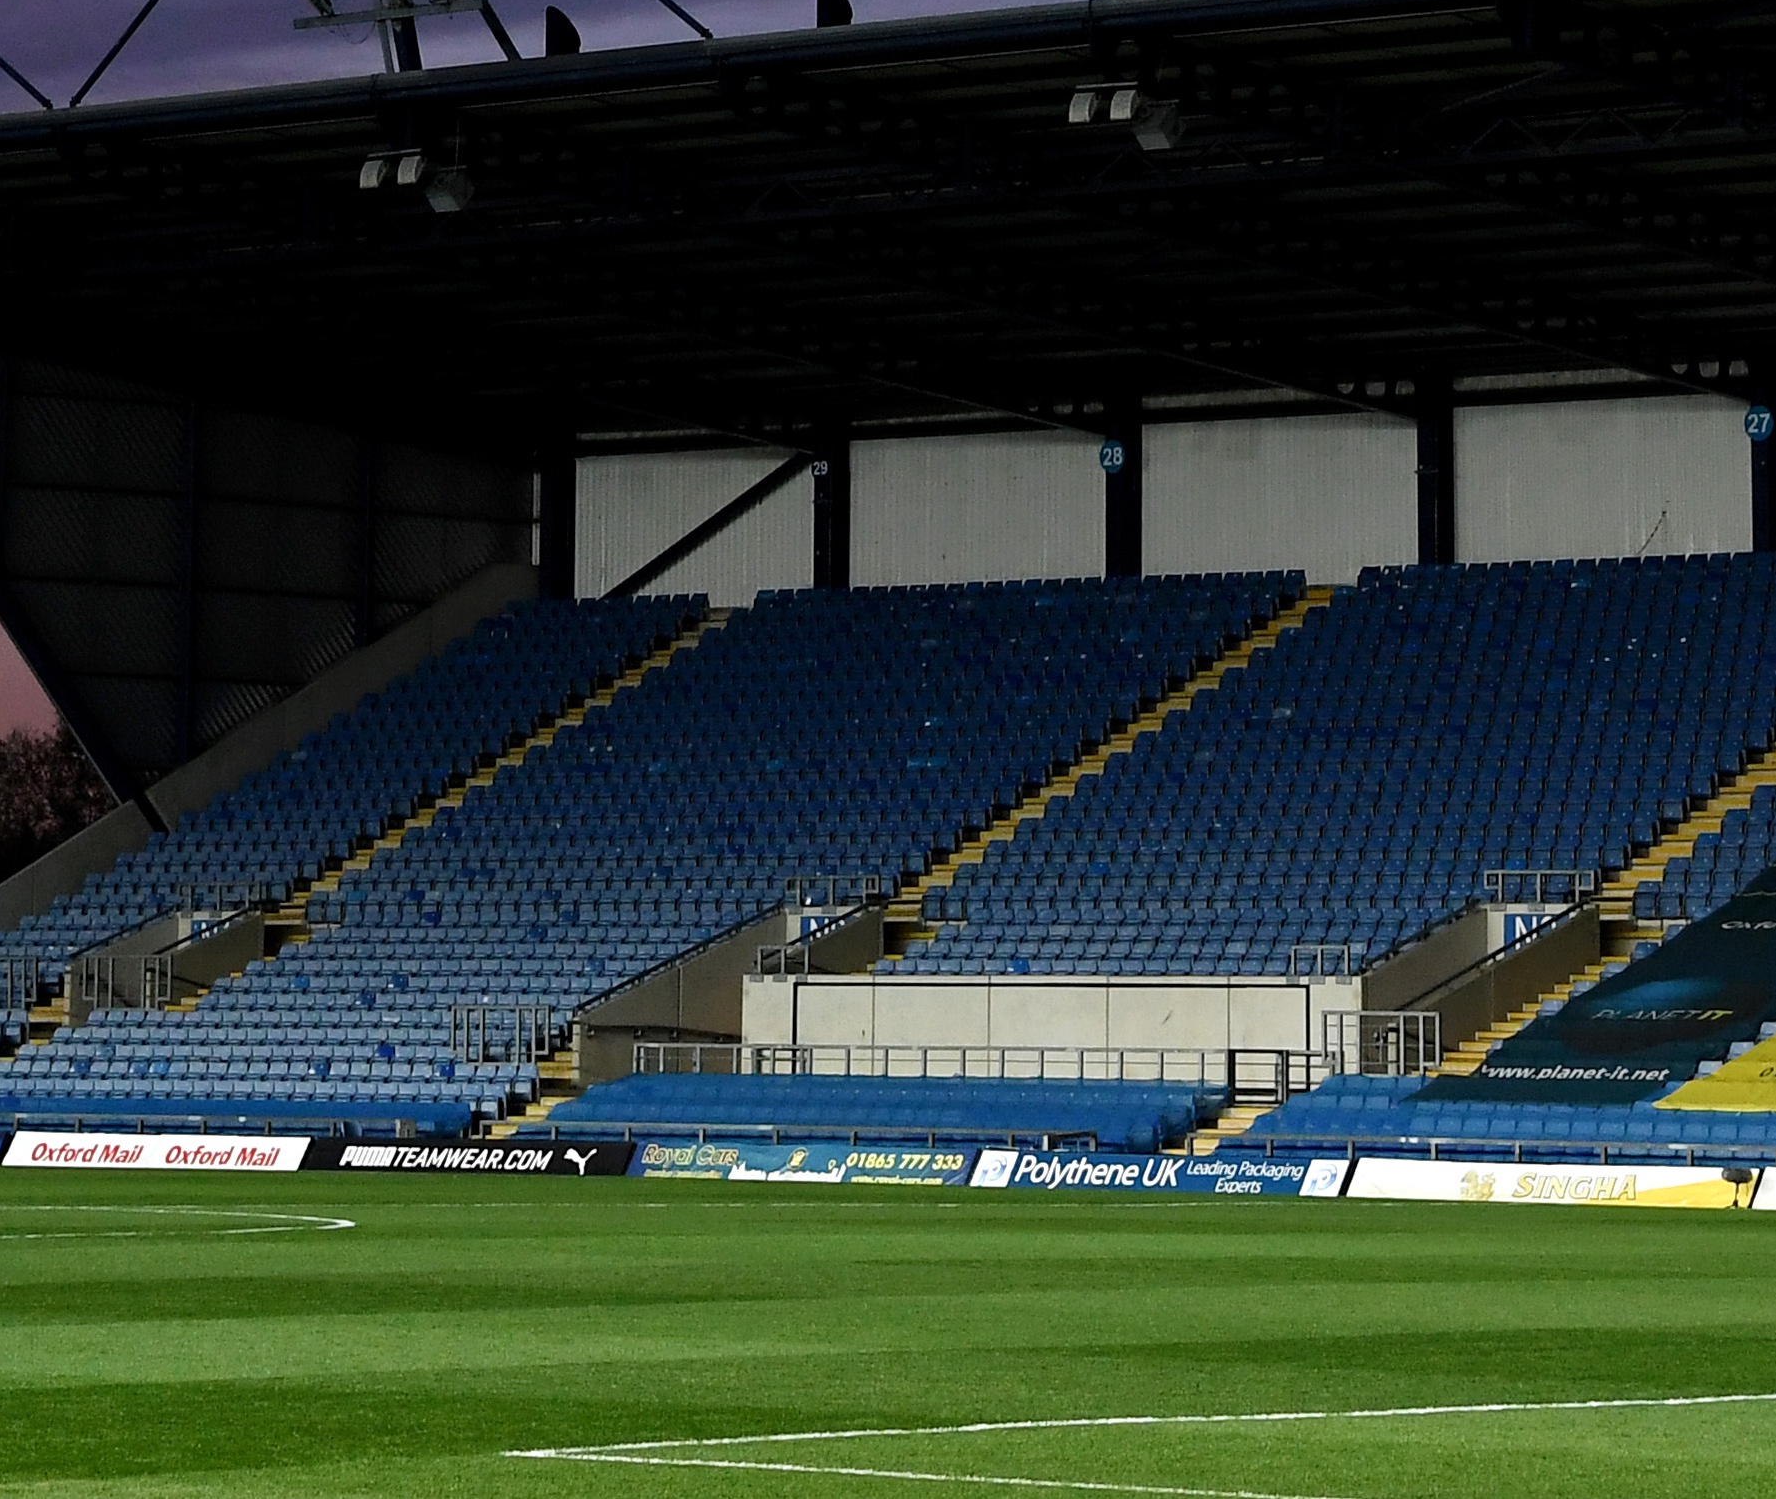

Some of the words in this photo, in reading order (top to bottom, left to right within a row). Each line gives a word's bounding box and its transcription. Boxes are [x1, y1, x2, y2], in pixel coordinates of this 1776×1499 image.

[1747, 412, 1771, 434] 27
[1102, 446, 1123, 466] 28
[812, 460, 828, 476] 29
[1481, 1063, 1670, 1082] www.planet-it.net
[30, 1142, 99, 1163] Oxford
[97, 1144, 144, 1164] Mail
[164, 1145, 235, 1166] Oxford
[234, 1147, 281, 1167] Mail
[339, 1145, 554, 1171] PUMATEAMWEAR.COM
[641, 1143, 697, 1168] Royal
[696, 1144, 739, 1166] Cars
[846, 1152, 896, 1169] 01865
[898, 1154, 931, 1170] 777
[931, 1154, 964, 1171] 333
[1014, 1154, 1139, 1190] Polythene
[1141, 1157, 1186, 1187] UK
[1186, 1159, 1238, 1177] Leading
[1238, 1161, 1304, 1181] Packaging
[1214, 1177, 1263, 1194] Experts
[1512, 1171, 1637, 1201] SINGHA
